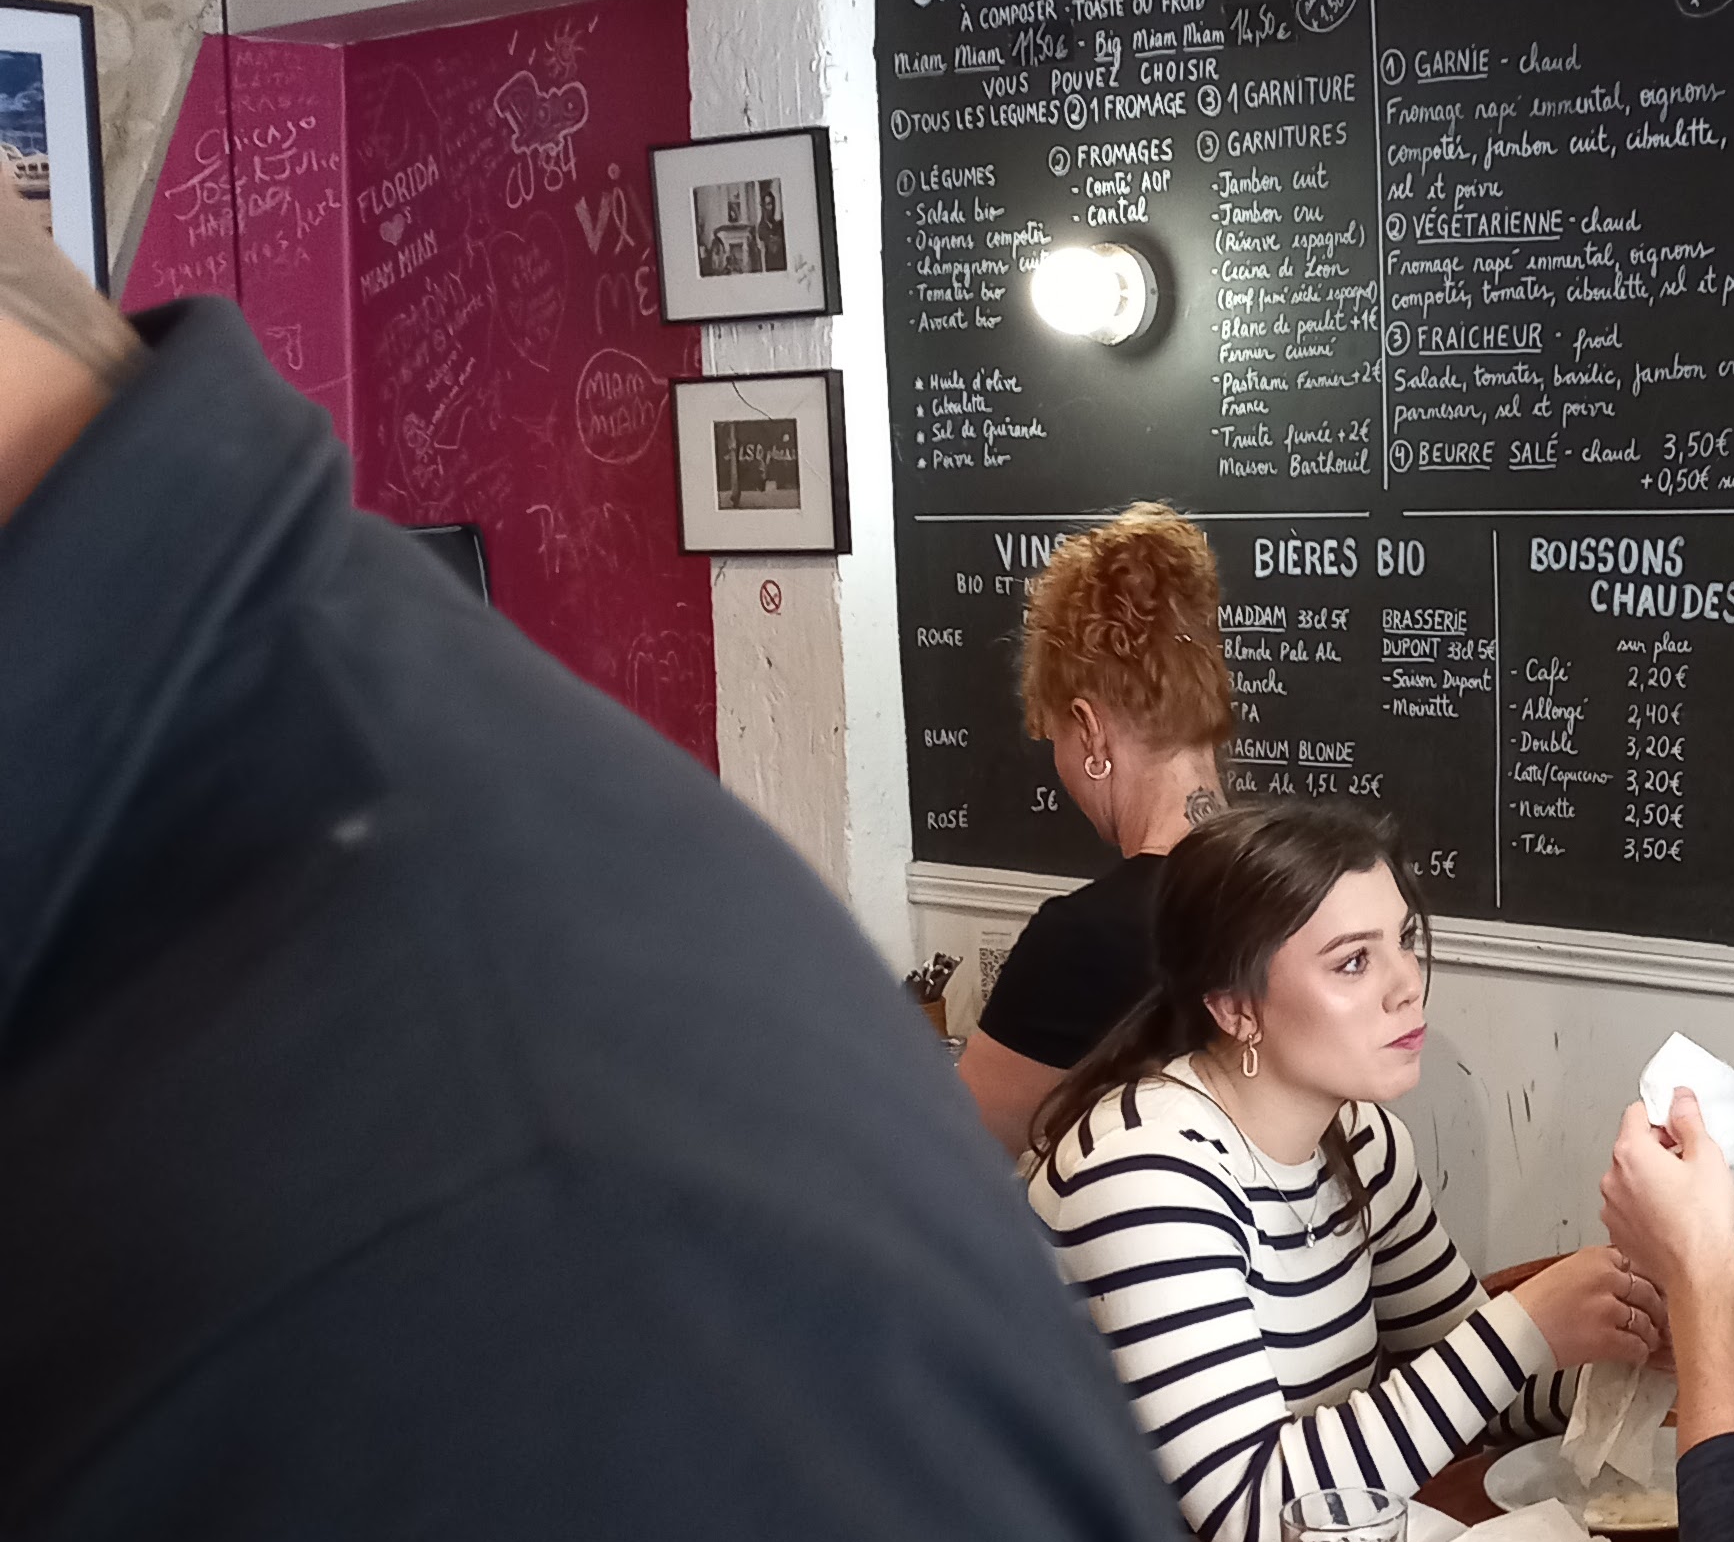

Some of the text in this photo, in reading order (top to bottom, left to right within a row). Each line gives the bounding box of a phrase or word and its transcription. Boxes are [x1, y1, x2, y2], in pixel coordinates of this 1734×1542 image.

[982, 58, 1219, 99] VOUS POUVEZ CHOISIR
[911, 111, 950, 133] TOUS
[956, 106, 984, 130] LES
[1105, 92, 1186, 120] FROMAGE
[1228, 122, 1346, 156] GARNITURES
[1078, 138, 1172, 168] FROMAGES
[921, 165, 995, 190] LÉGUMES
[1419, 442, 1494, 464] BEURRE
[1510, 432, 1558, 463] SALÉ
[1664, 428, 1732, 464] 3,50€
[1255, 529, 1424, 577] BIÈRES BIO
[1531, 536, 1684, 576] BOISSONS
[957, 573, 982, 593] BIO
[1218, 605, 1287, 628] MADDAM
[918, 628, 962, 647] ROUGE
[1383, 638, 1441, 658] DUPONT
[1628, 665, 1688, 692] 2,20€
[925, 729, 968, 747] BLANC
[1299, 740, 1355, 761] BLONDE
[928, 804, 968, 829] ROSÉ
